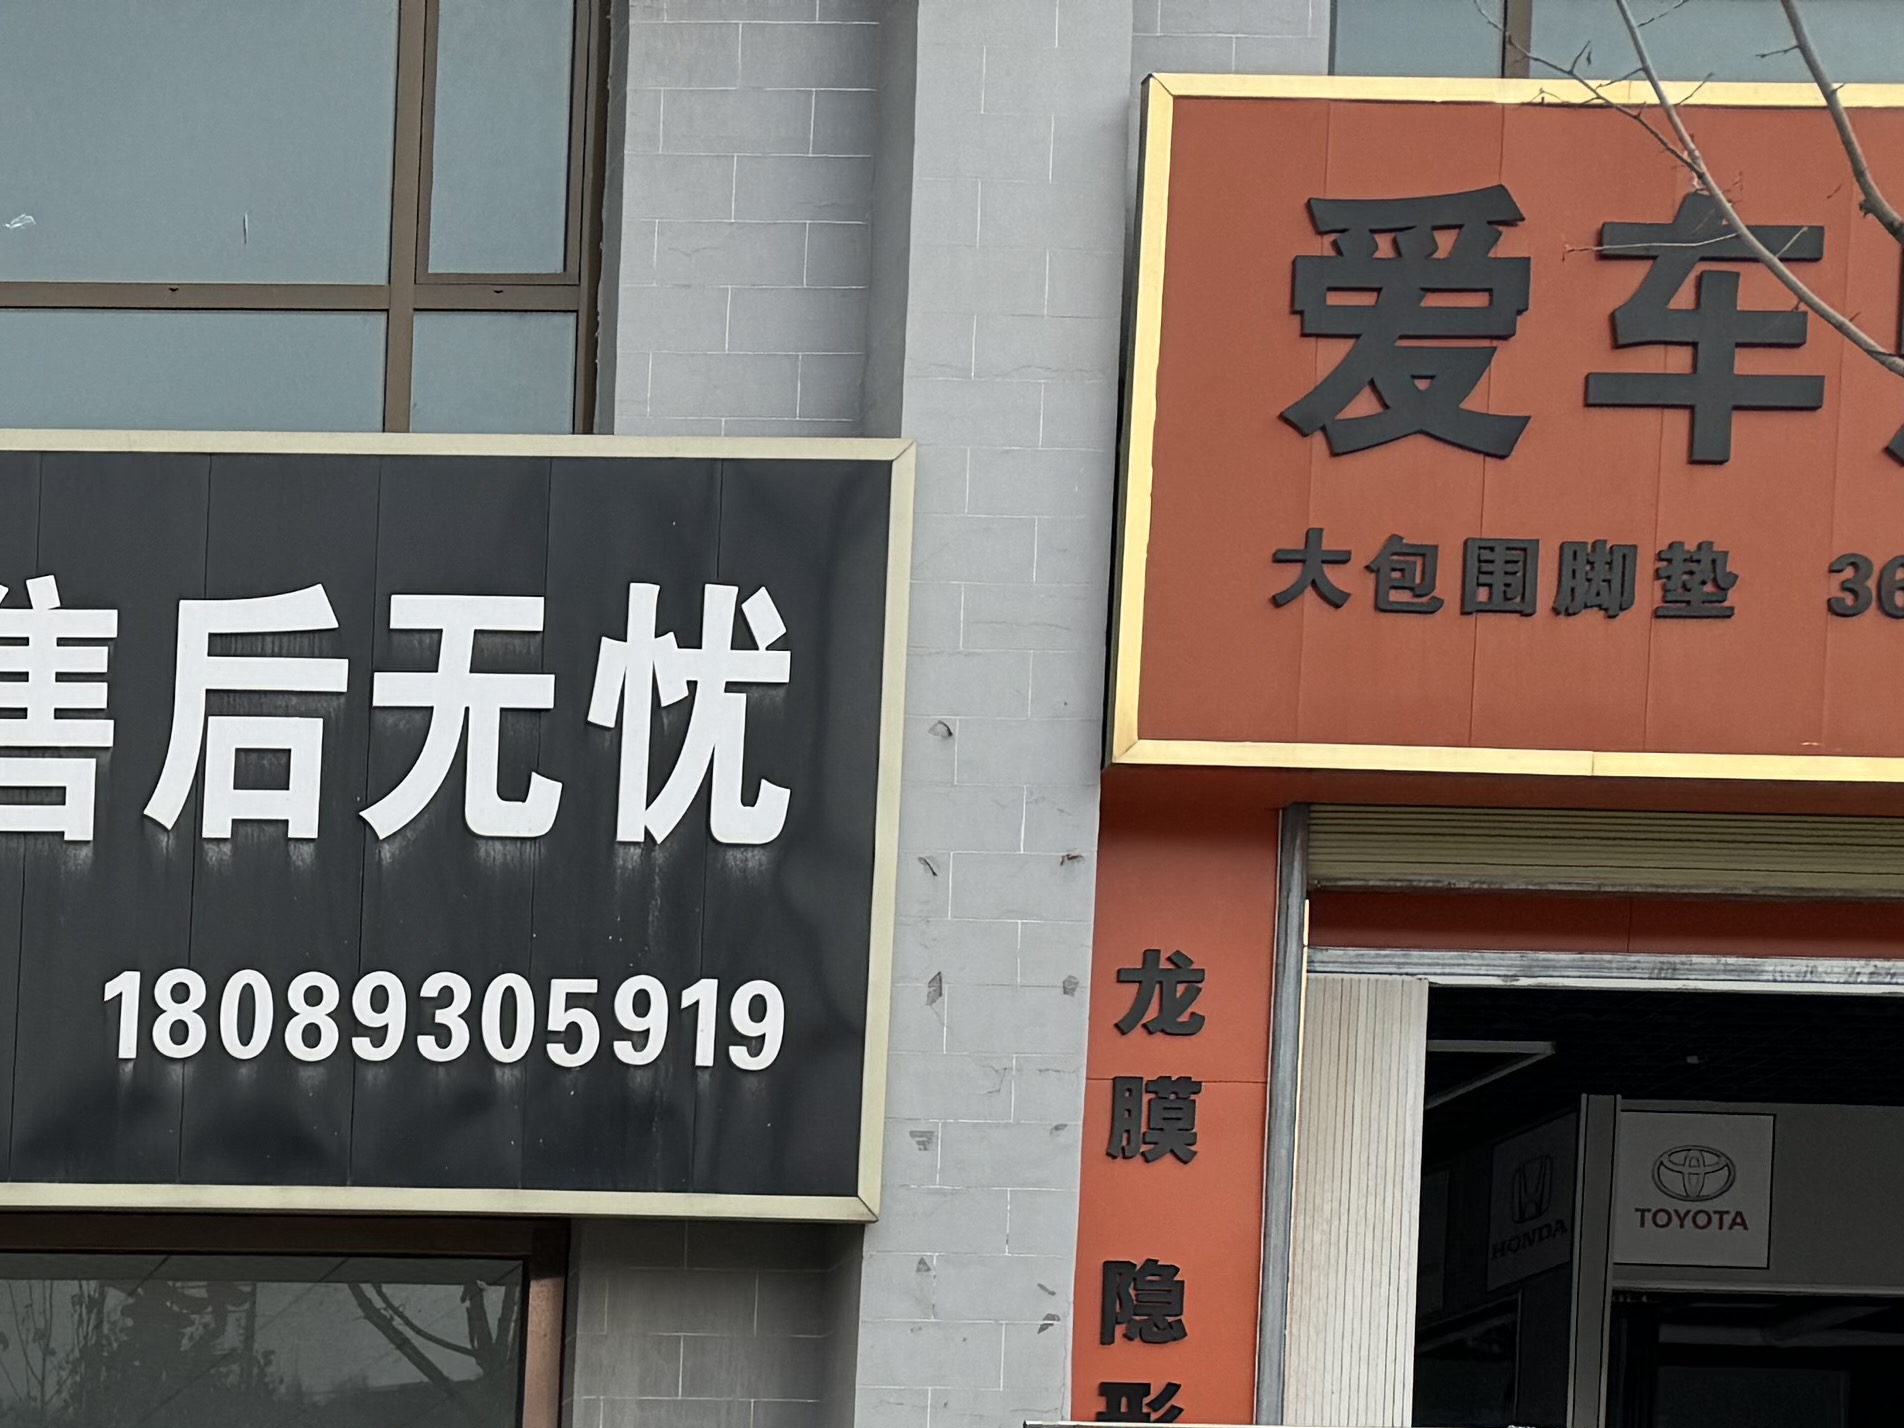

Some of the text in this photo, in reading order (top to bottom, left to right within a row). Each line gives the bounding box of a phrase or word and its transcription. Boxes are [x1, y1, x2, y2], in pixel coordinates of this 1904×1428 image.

[1268, 527, 1740, 620] 大包围脚垫
[102, 968, 785, 1071] 18089305919
[1104, 947, 1207, 1165] 龙膜
[1491, 1218, 1569, 1261] HONDA
[1634, 1207, 1749, 1231] TOYOTA
